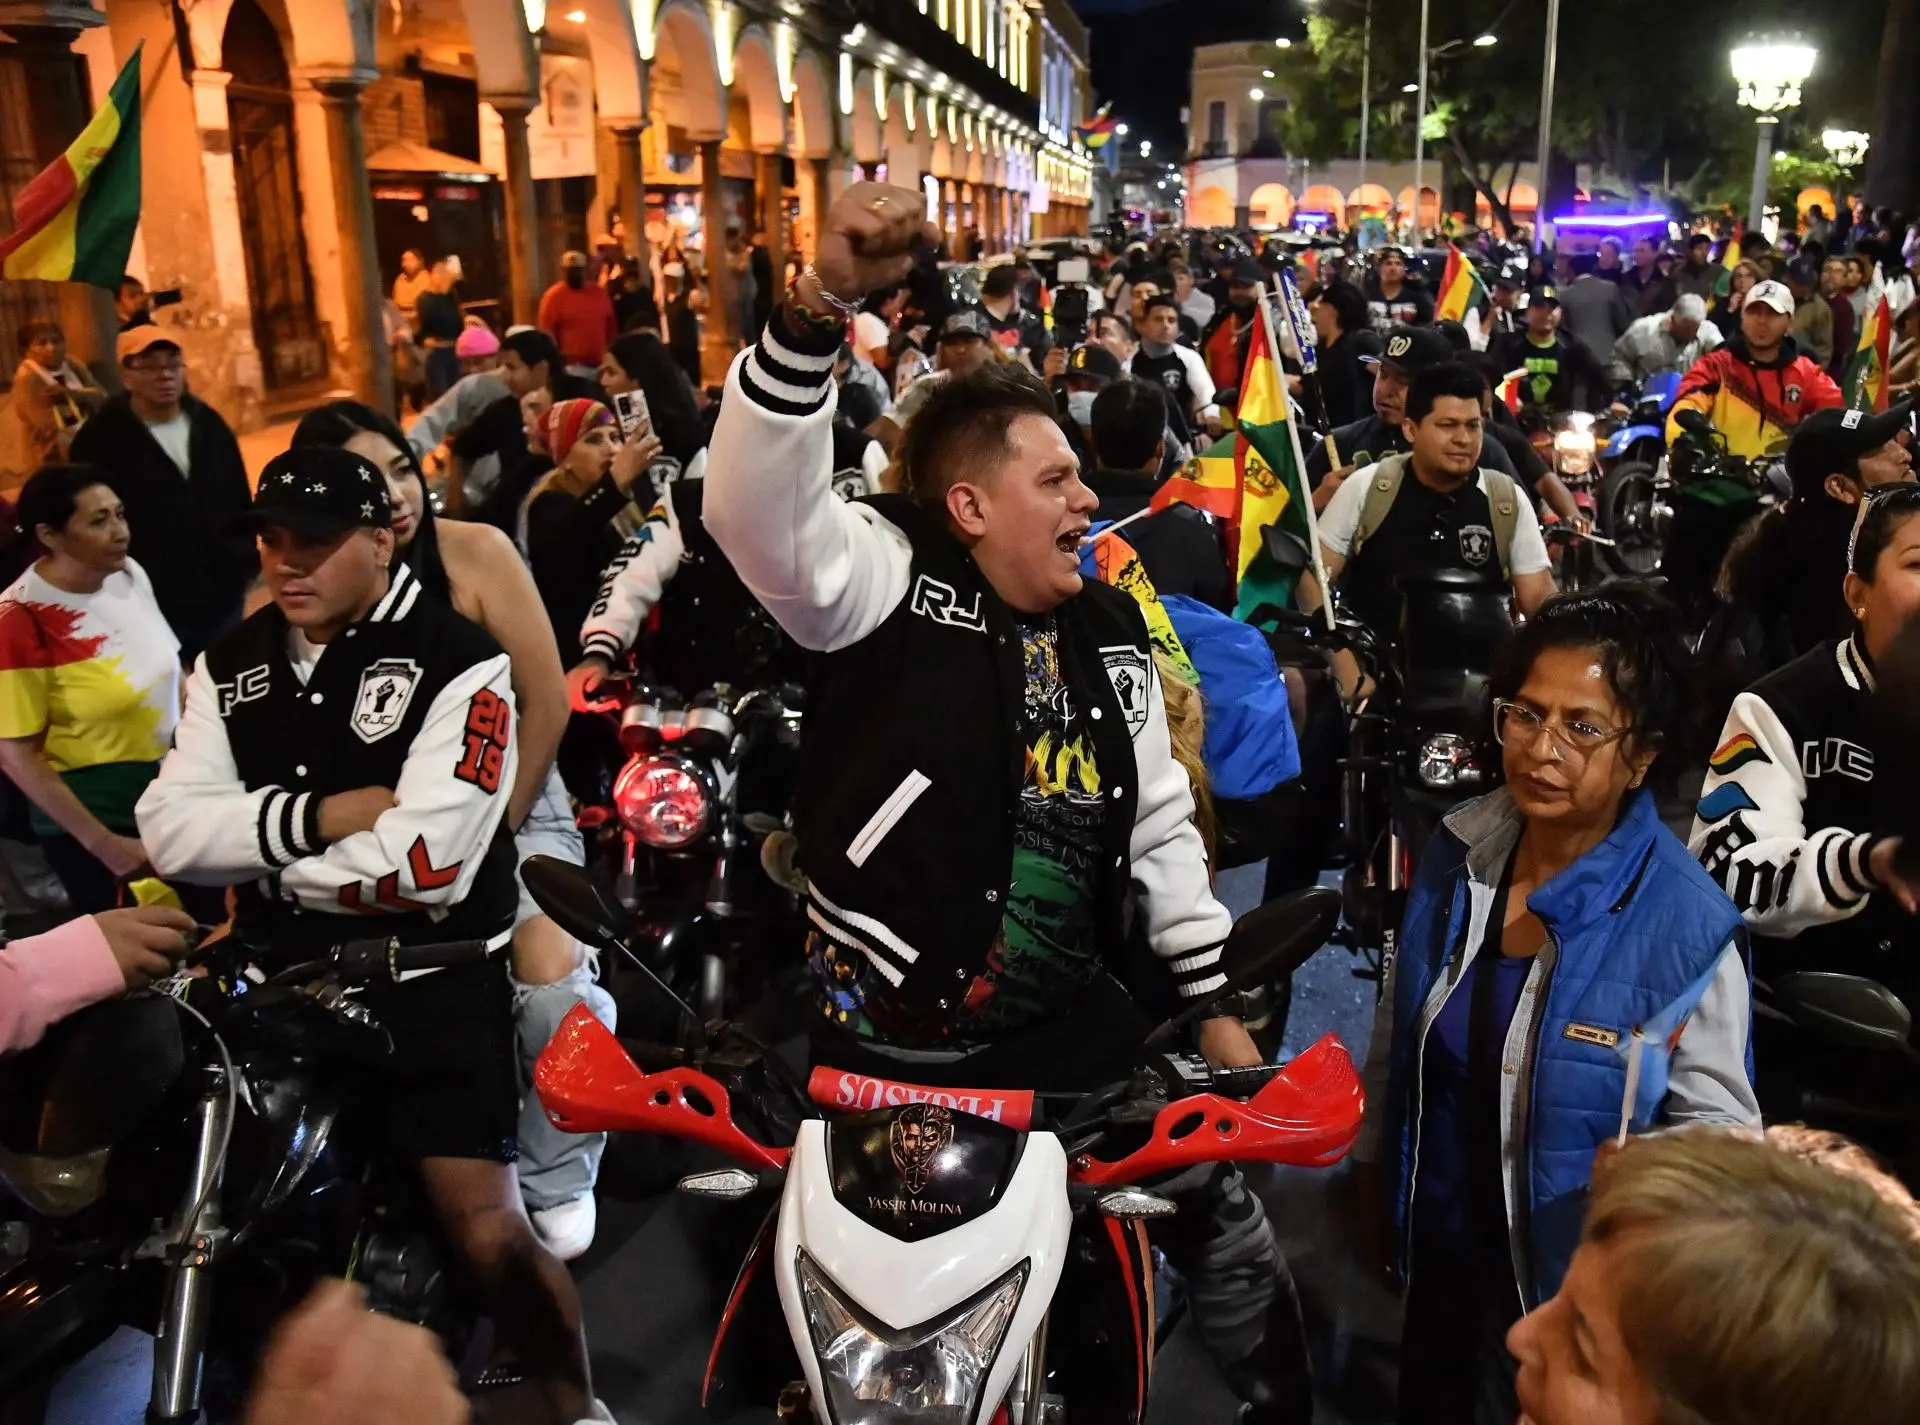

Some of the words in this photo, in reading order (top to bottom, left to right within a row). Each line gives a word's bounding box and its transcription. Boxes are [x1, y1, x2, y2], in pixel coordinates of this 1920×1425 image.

[1387, 335, 1412, 357] W
[910, 572, 988, 635] RJ
[358, 713, 393, 726] RJC
[465, 686, 511, 751] 20
[453, 732, 505, 797] 19
[867, 1196, 907, 1212] YASSIR
[910, 1198, 962, 1215] MOLINA
